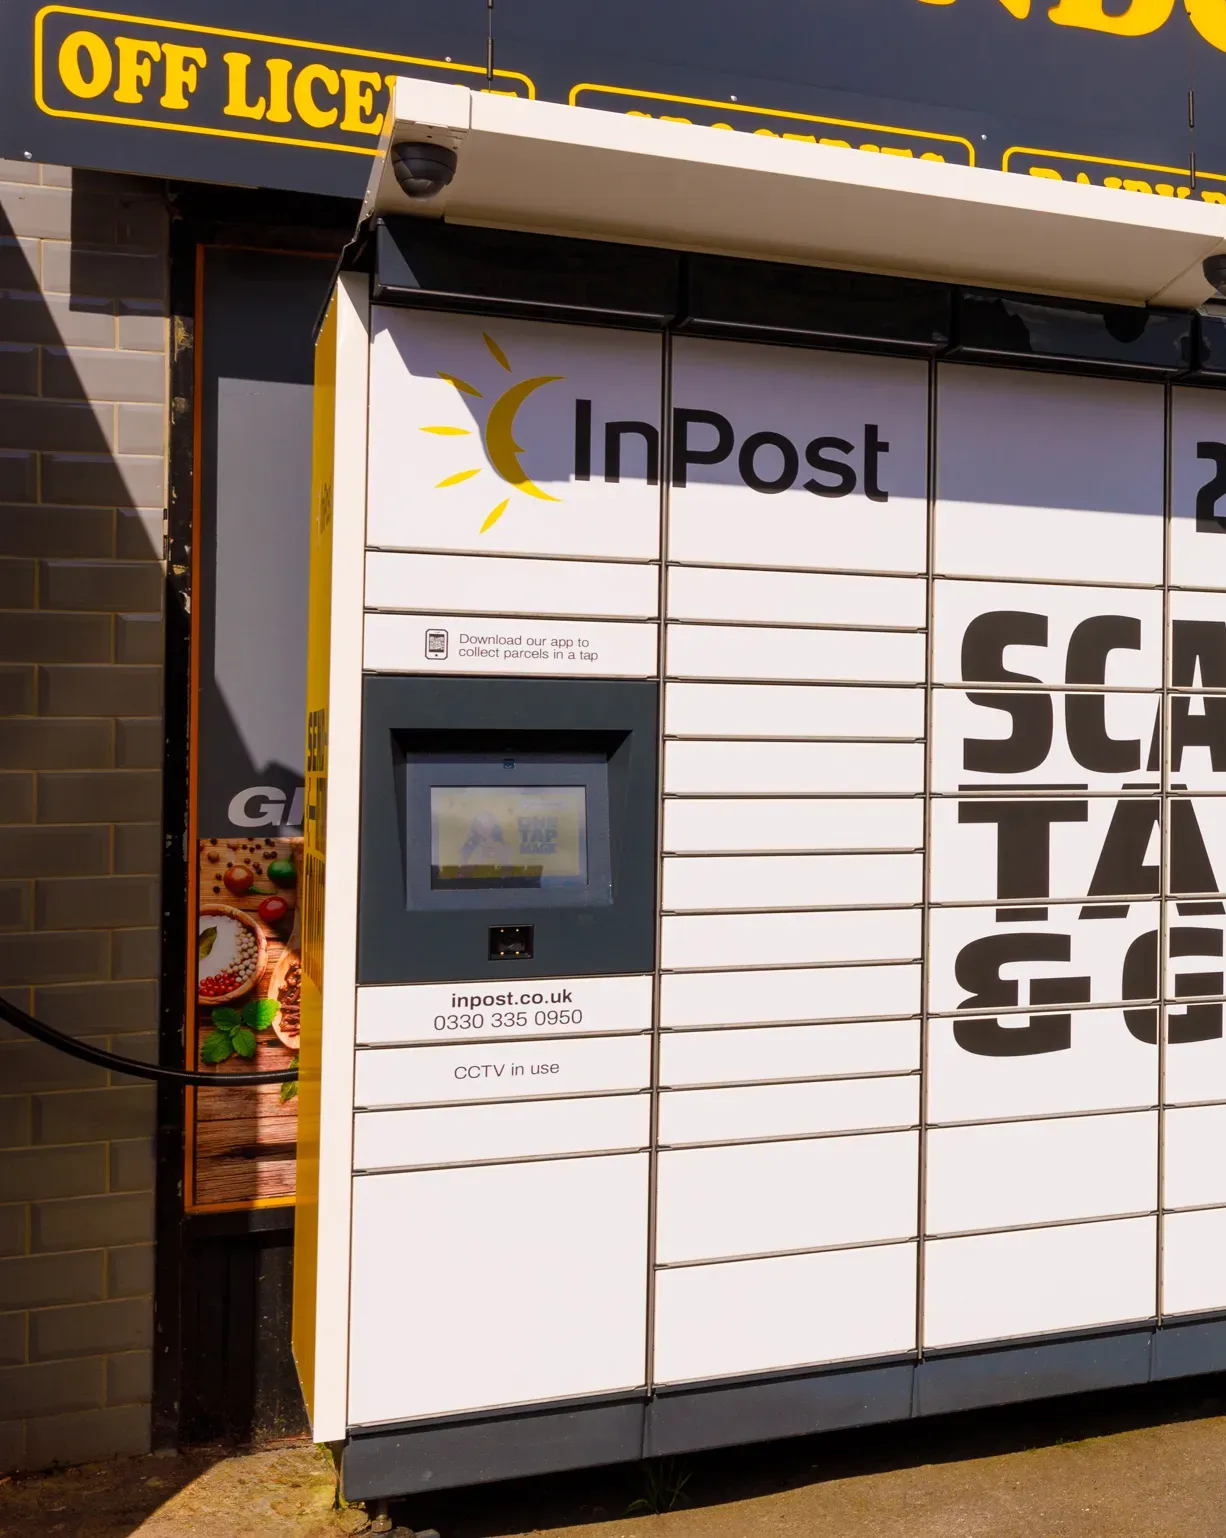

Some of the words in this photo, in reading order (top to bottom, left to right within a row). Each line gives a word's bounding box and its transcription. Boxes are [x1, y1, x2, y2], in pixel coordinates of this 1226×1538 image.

[58, 30, 207, 110] OFF
[574, 398, 890, 503] InPost
[459, 633, 522, 646] Download
[526, 637, 547, 646] our
[550, 637, 574, 649] app
[578, 637, 589, 648] to
[458, 647, 500, 658] collect
[503, 647, 549, 660] parcels
[553, 648, 564, 659] in
[567, 650, 576, 660] a
[580, 650, 599, 662] tap
[451, 989, 573, 1010] inpost.co.uk
[953, 932, 1091, 1058] &
[434, 1014, 484, 1031] 0330
[491, 1011, 528, 1028] 335
[534, 1009, 583, 1026] 0950
[454, 1064, 505, 1080] CCTV
[511, 1063, 524, 1076] in
[530, 1063, 560, 1075] use
